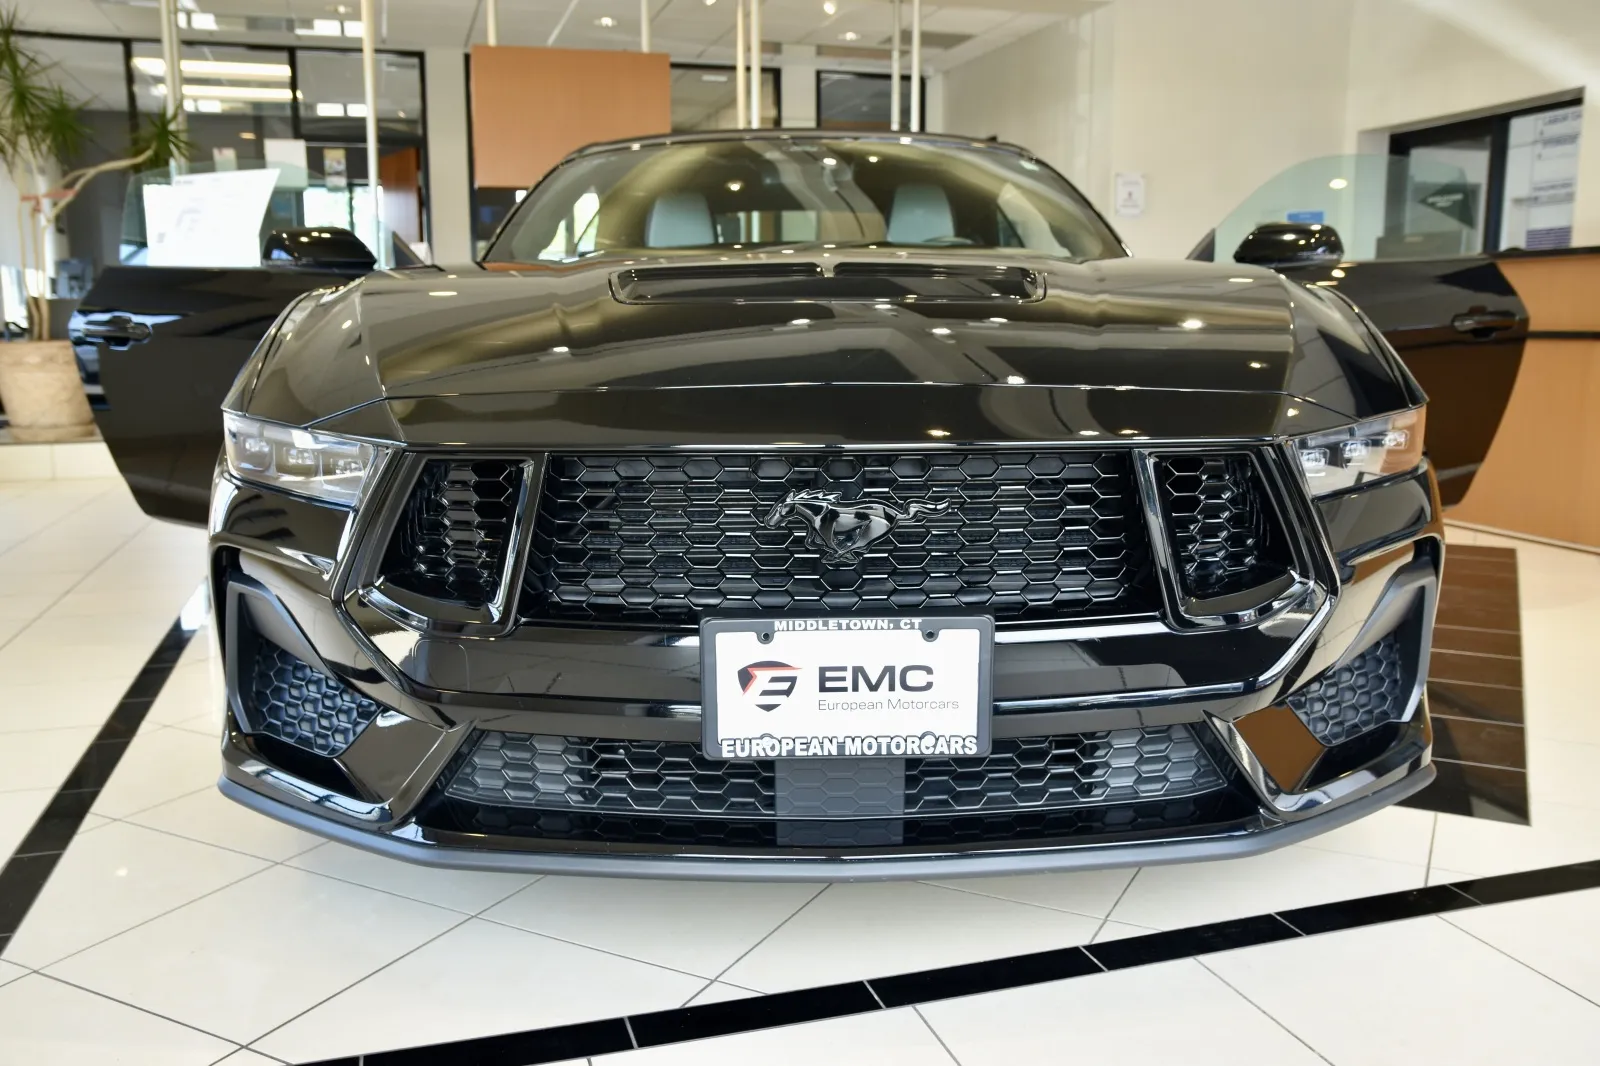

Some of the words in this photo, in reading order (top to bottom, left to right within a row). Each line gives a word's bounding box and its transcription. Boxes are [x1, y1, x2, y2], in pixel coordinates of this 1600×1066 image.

[774, 620, 894, 631] MIDDLETOWN,
[900, 619, 922, 630] CT
[818, 664, 934, 693] EMC
[818, 699, 883, 711] European
[887, 698, 960, 710] Motorcars
[721, 736, 838, 758] EUROPEAN
[844, 734, 978, 756] MOTORCARS
